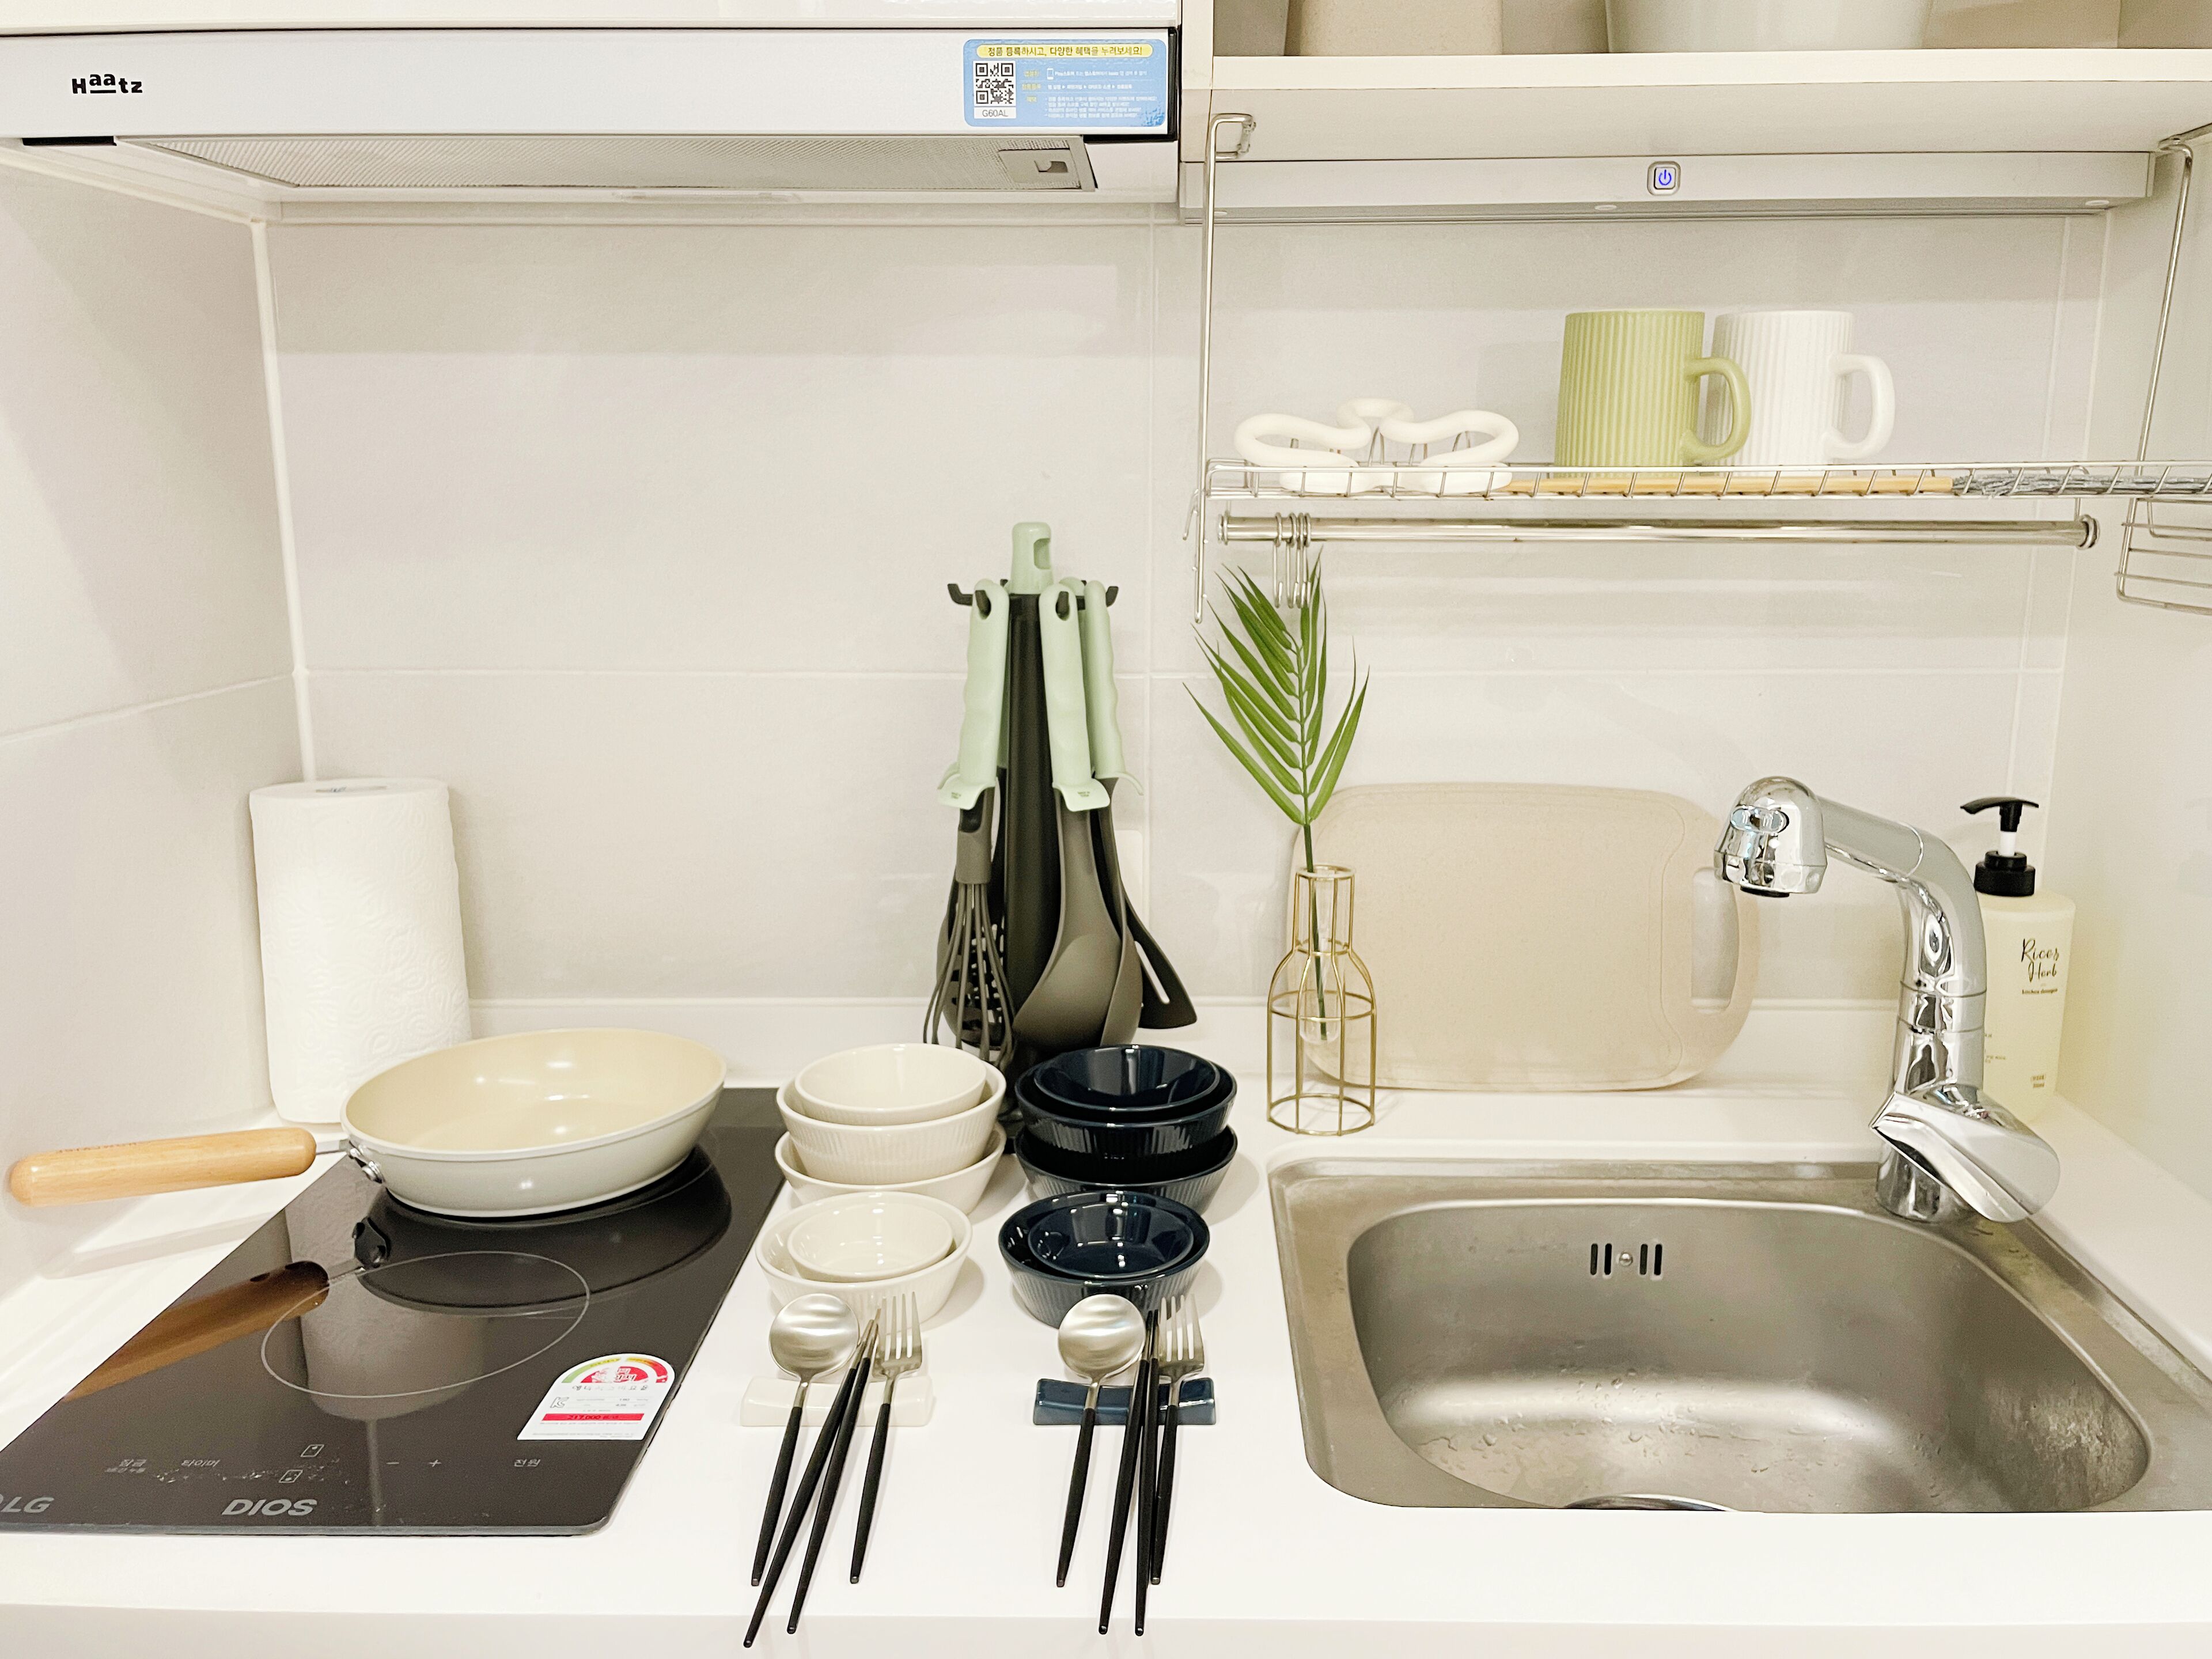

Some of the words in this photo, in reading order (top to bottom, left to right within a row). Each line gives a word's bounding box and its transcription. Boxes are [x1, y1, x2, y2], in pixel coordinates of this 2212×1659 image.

[1050, 47, 1073, 56] 다양한
[71, 73, 143, 94] Haatz
[982, 109, 1009, 118] G60AL
[181, 1459, 221, 1468] 타이머
[514, 1458, 541, 1468] 전원
[1, 1496, 55, 1514] LG
[221, 1498, 318, 1516] DIOS
